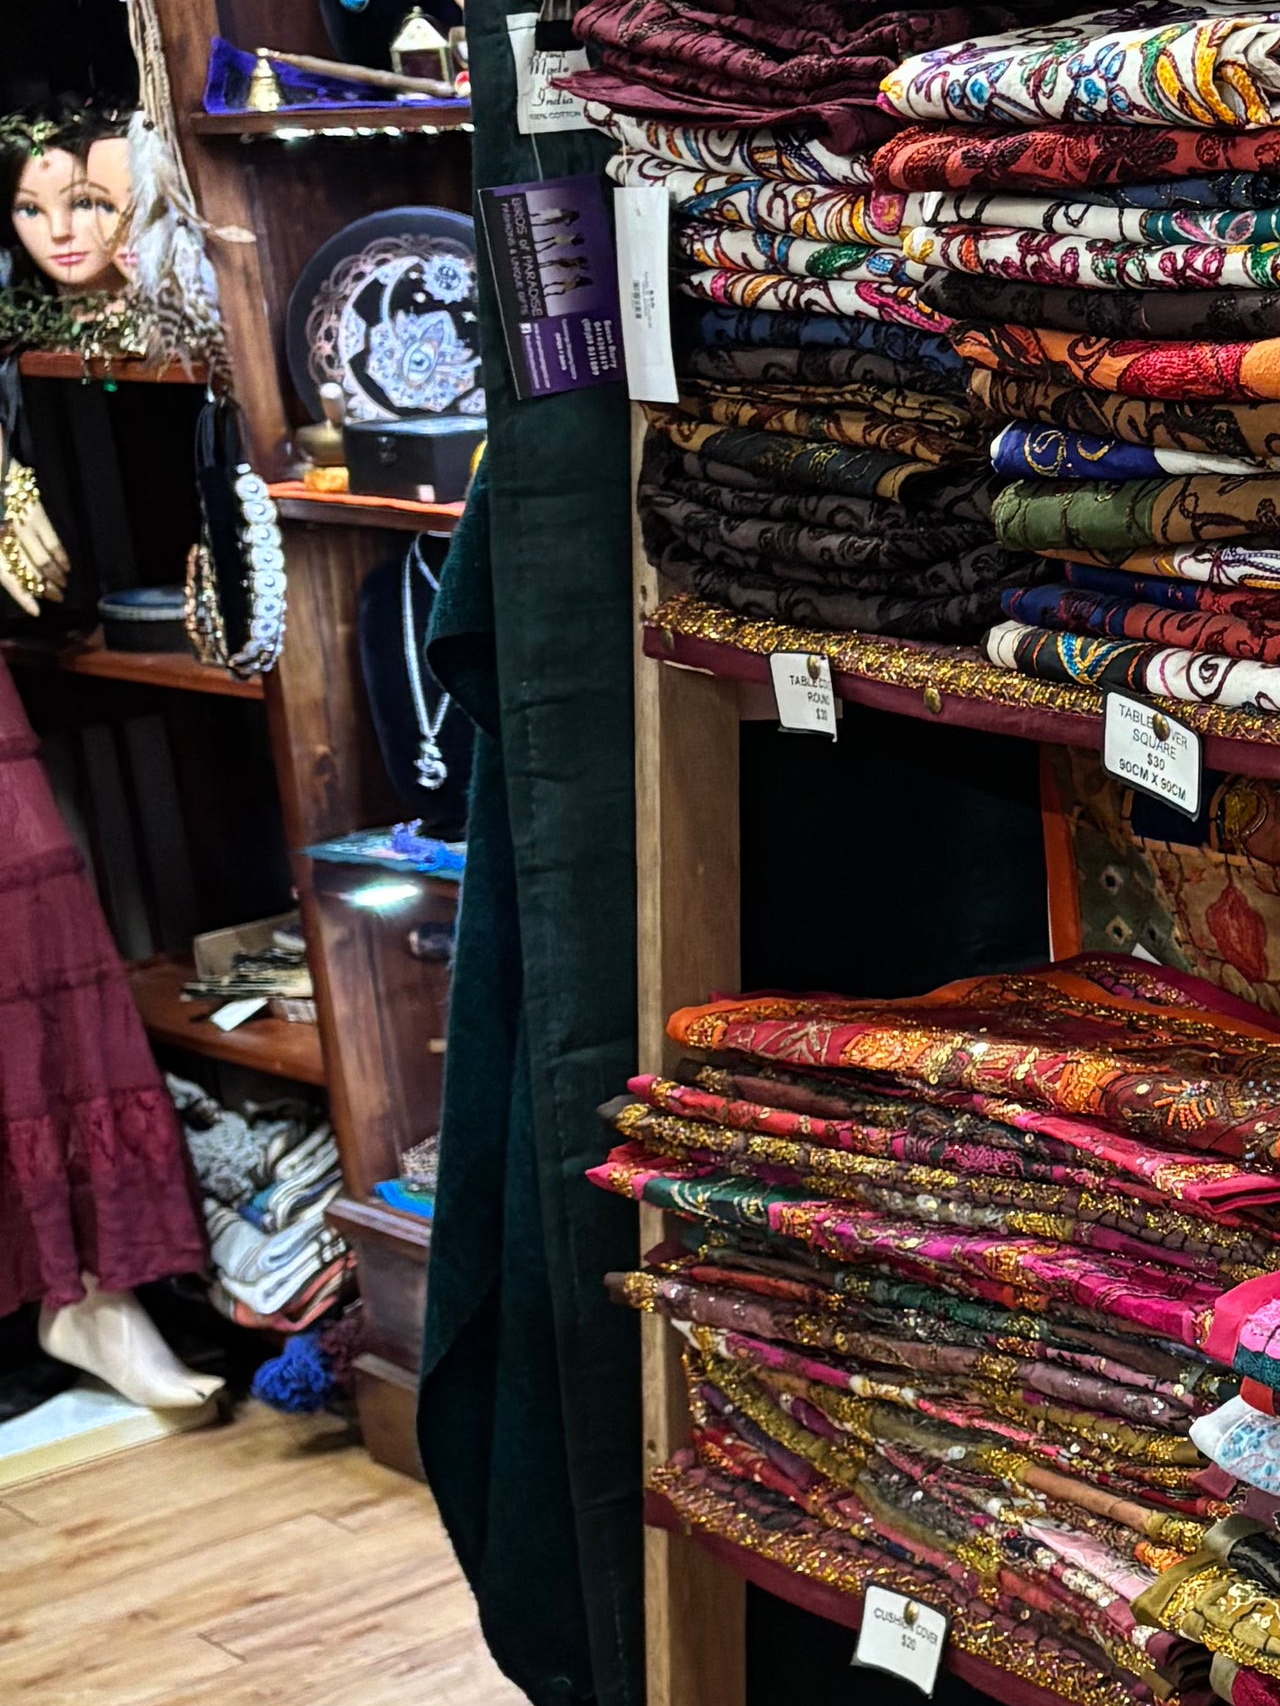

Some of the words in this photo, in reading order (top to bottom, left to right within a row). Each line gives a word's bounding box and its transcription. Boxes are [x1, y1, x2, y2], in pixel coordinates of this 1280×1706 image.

[550, 110, 582, 120] COTTON
[522, 254, 544, 318] PARADISE
[1119, 703, 1154, 729] TABLE
[1132, 728, 1176, 760] SQUARE
[1146, 752, 1166, 771] $30
[1118, 758, 1149, 782] 90CM
[1151, 772, 1158, 786] X
[1160, 777, 1187, 802] 90CM
